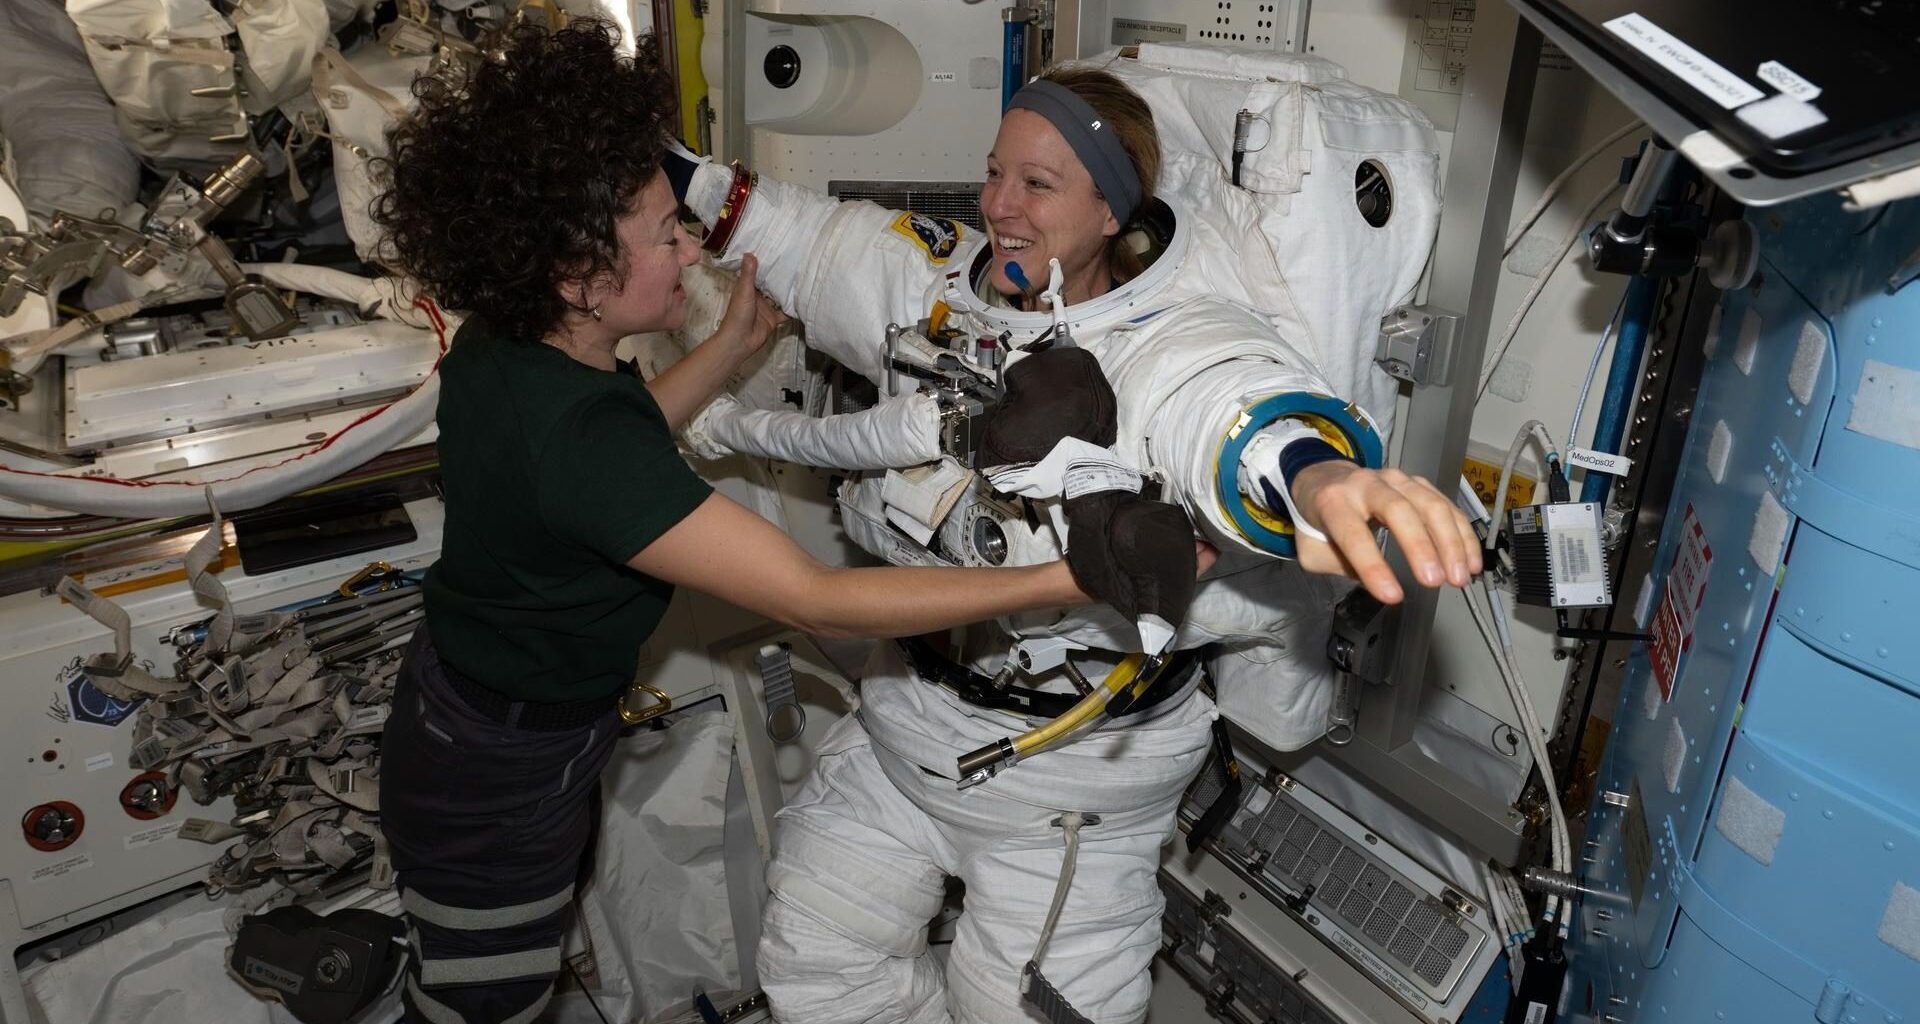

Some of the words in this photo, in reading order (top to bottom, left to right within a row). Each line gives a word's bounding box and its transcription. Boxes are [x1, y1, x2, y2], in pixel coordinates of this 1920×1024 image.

[1150, 25, 1181, 34] RECEPTACLE
[1572, 451, 1614, 467] MedOps02
[1682, 556, 1695, 594] FIRE
[1660, 649, 1674, 689] PFE
